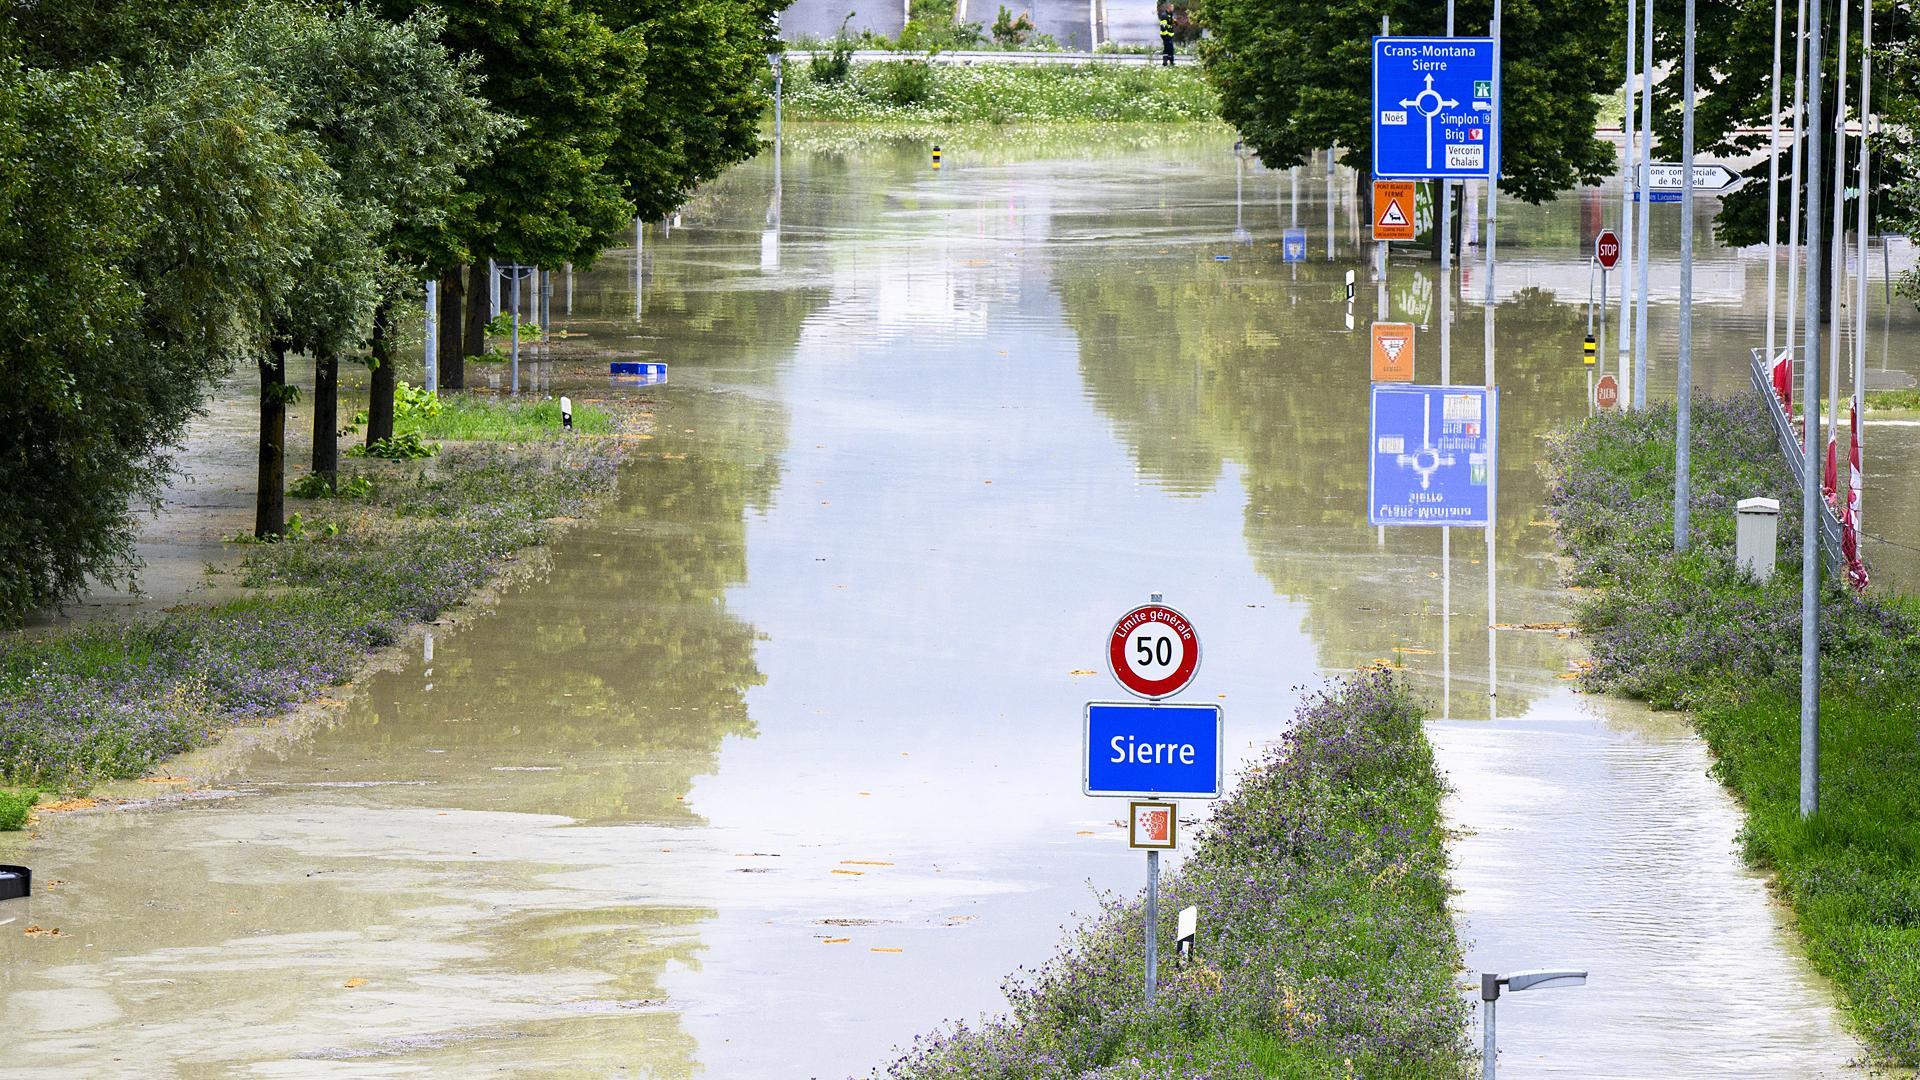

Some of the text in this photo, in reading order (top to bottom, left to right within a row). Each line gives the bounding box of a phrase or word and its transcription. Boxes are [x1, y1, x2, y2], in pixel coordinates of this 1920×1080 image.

[1384, 45, 1476, 57] Crans-Montana
[1412, 59, 1447, 71] Sierre
[1384, 113, 1404, 122] Noës
[1440, 113, 1479, 127] Simplon
[1445, 128, 1465, 142] Brig
[1448, 146, 1481, 155] Vercorin
[1450, 157, 1479, 166] Chalais
[1669, 169, 1717, 177] comerciale
[1658, 177, 1667, 185] de
[1600, 244, 1617, 256] STOP
[1116, 609, 1192, 641] Limite générale
[1137, 636, 1172, 667] 50
[1110, 735, 1195, 765] Sierre
